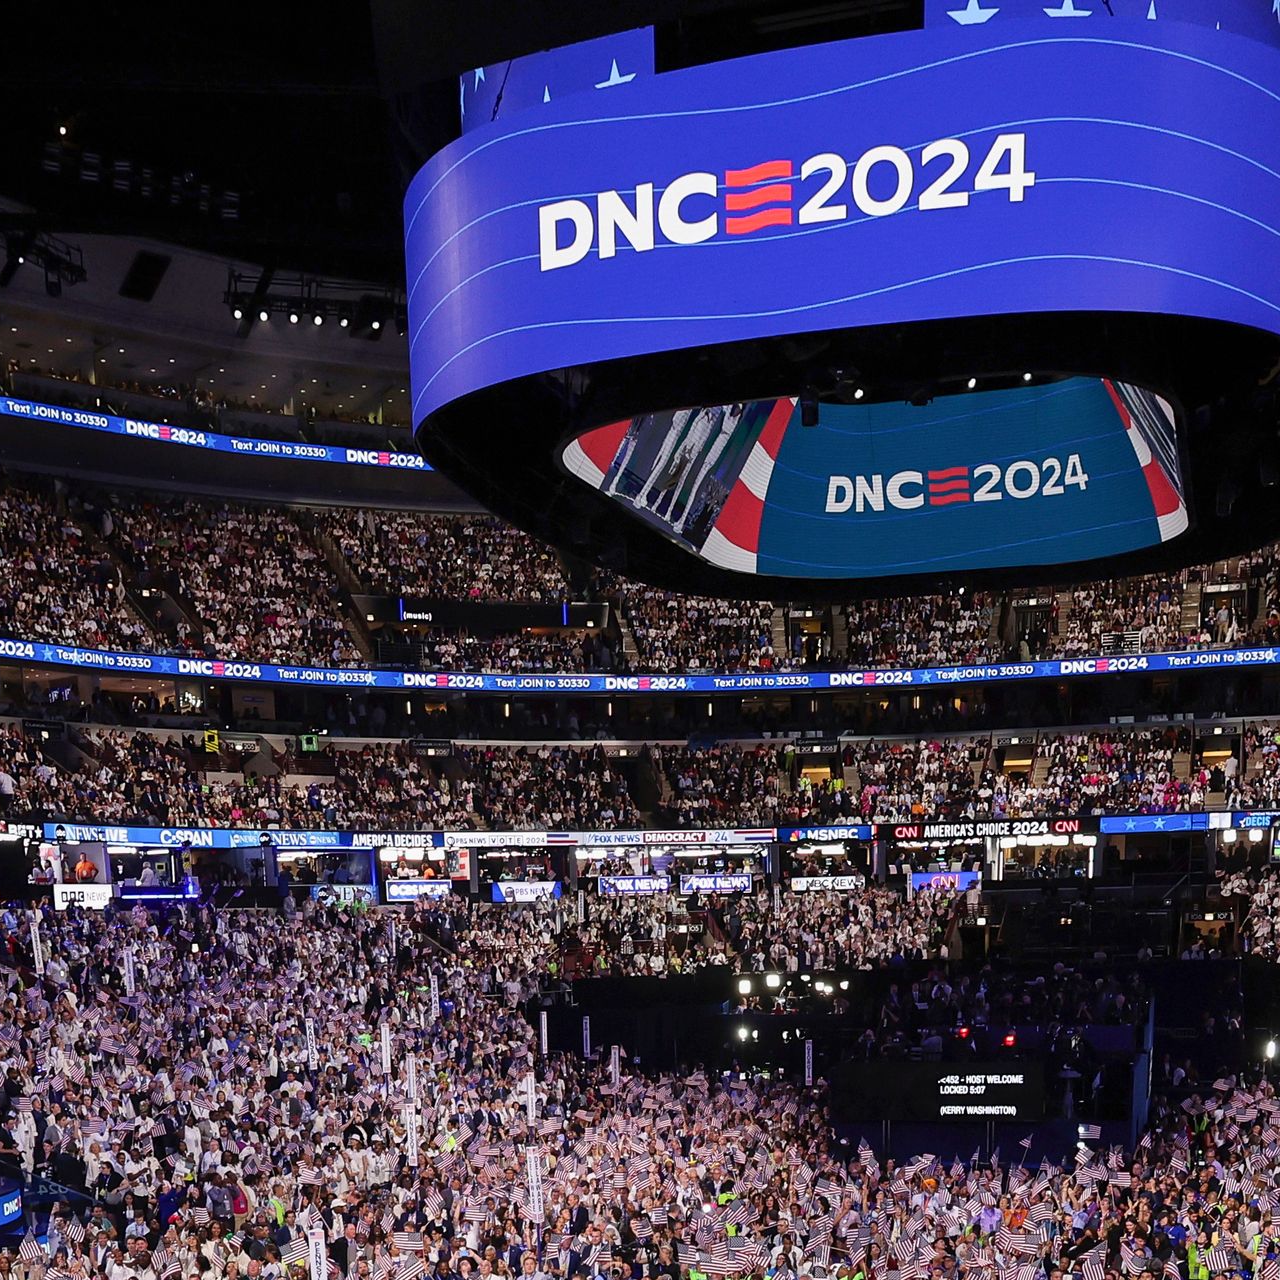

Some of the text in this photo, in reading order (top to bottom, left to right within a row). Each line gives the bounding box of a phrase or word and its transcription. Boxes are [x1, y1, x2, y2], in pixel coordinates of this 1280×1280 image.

[538, 132, 1036, 272] DNC 2024
[346, 449, 424, 468] DNC 2024
[825, 453, 1088, 515] DNC 2024
[829, 671, 912, 687] DNC 2024
[66, 827, 98, 841] NEWS
[807, 828, 859, 840] MSNBC
[895, 820, 1079, 838] CNN AMERICA'S CHOICE 2024 CNN
[272, 833, 307, 846] NEWS
[352, 833, 433, 847] AMERICA DECIDES
[614, 834, 640, 843] NEWS
[645, 832, 704, 843] DEMOCRACY
[635, 879, 669, 891] NEWS
[716, 876, 749, 889] NEWS
[931, 874, 959, 888] CNN
[86, 891, 107, 902] NEWS
[307, 1025, 316, 1063] KANSAS
[966, 1075, 985, 1083] HOST
[987, 1075, 1023, 1083] WELCOME
[940, 1086, 986, 1094] LOCKED 5:07
[940, 1106, 1016, 1116] (KERRY WASHINGTON)
